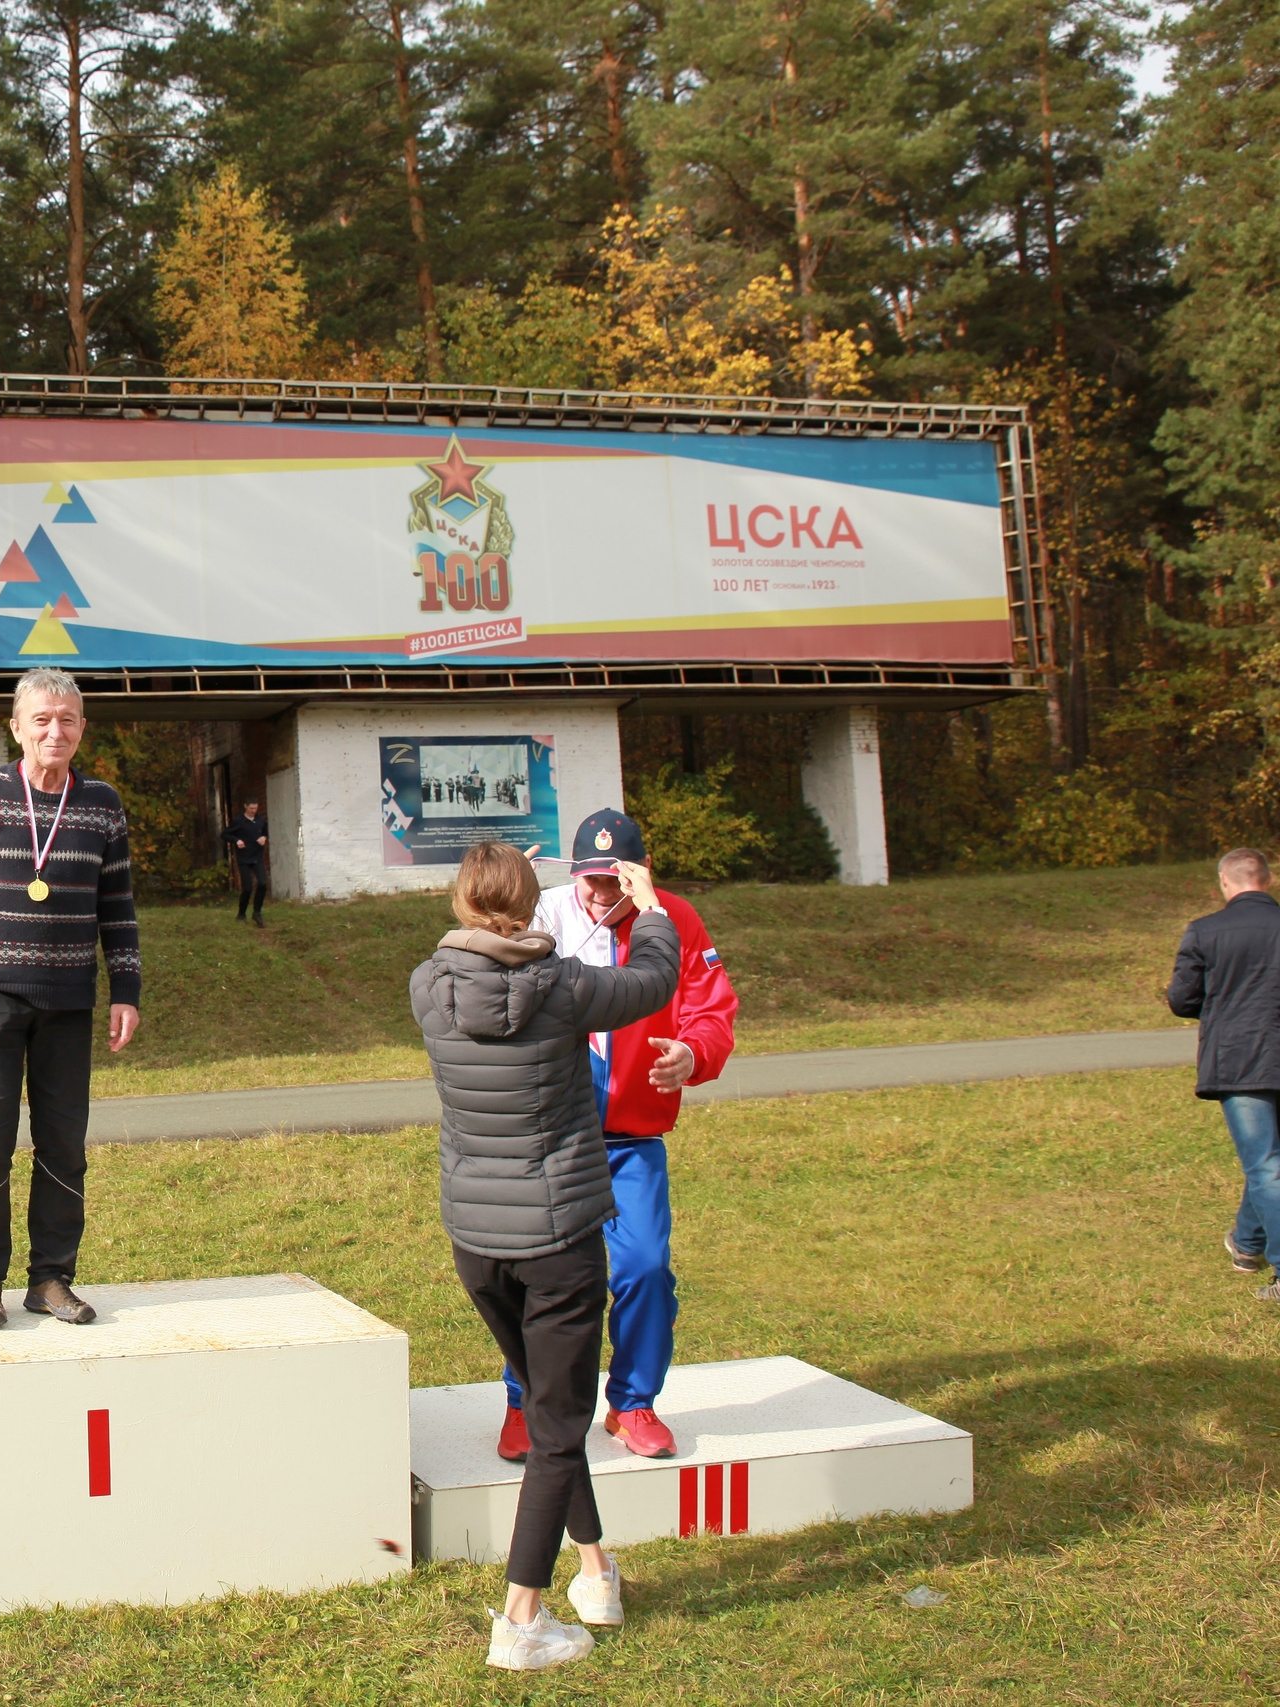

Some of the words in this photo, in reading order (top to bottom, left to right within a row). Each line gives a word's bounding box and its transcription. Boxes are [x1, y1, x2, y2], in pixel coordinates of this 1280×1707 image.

[436, 519, 480, 552] ЦСКА
[706, 504, 864, 553] ЦСКА
[711, 558, 754, 567] ЗОЛОТОЕ
[756, 558, 808, 568] СОЗВЕЗДИЕ
[418, 551, 511, 613] 100
[713, 578, 739, 592] 100
[743, 579, 770, 592] ЛЕТ
[811, 580, 836, 590] 1923
[410, 622, 517, 652] #100ЛЕТЦСКА
